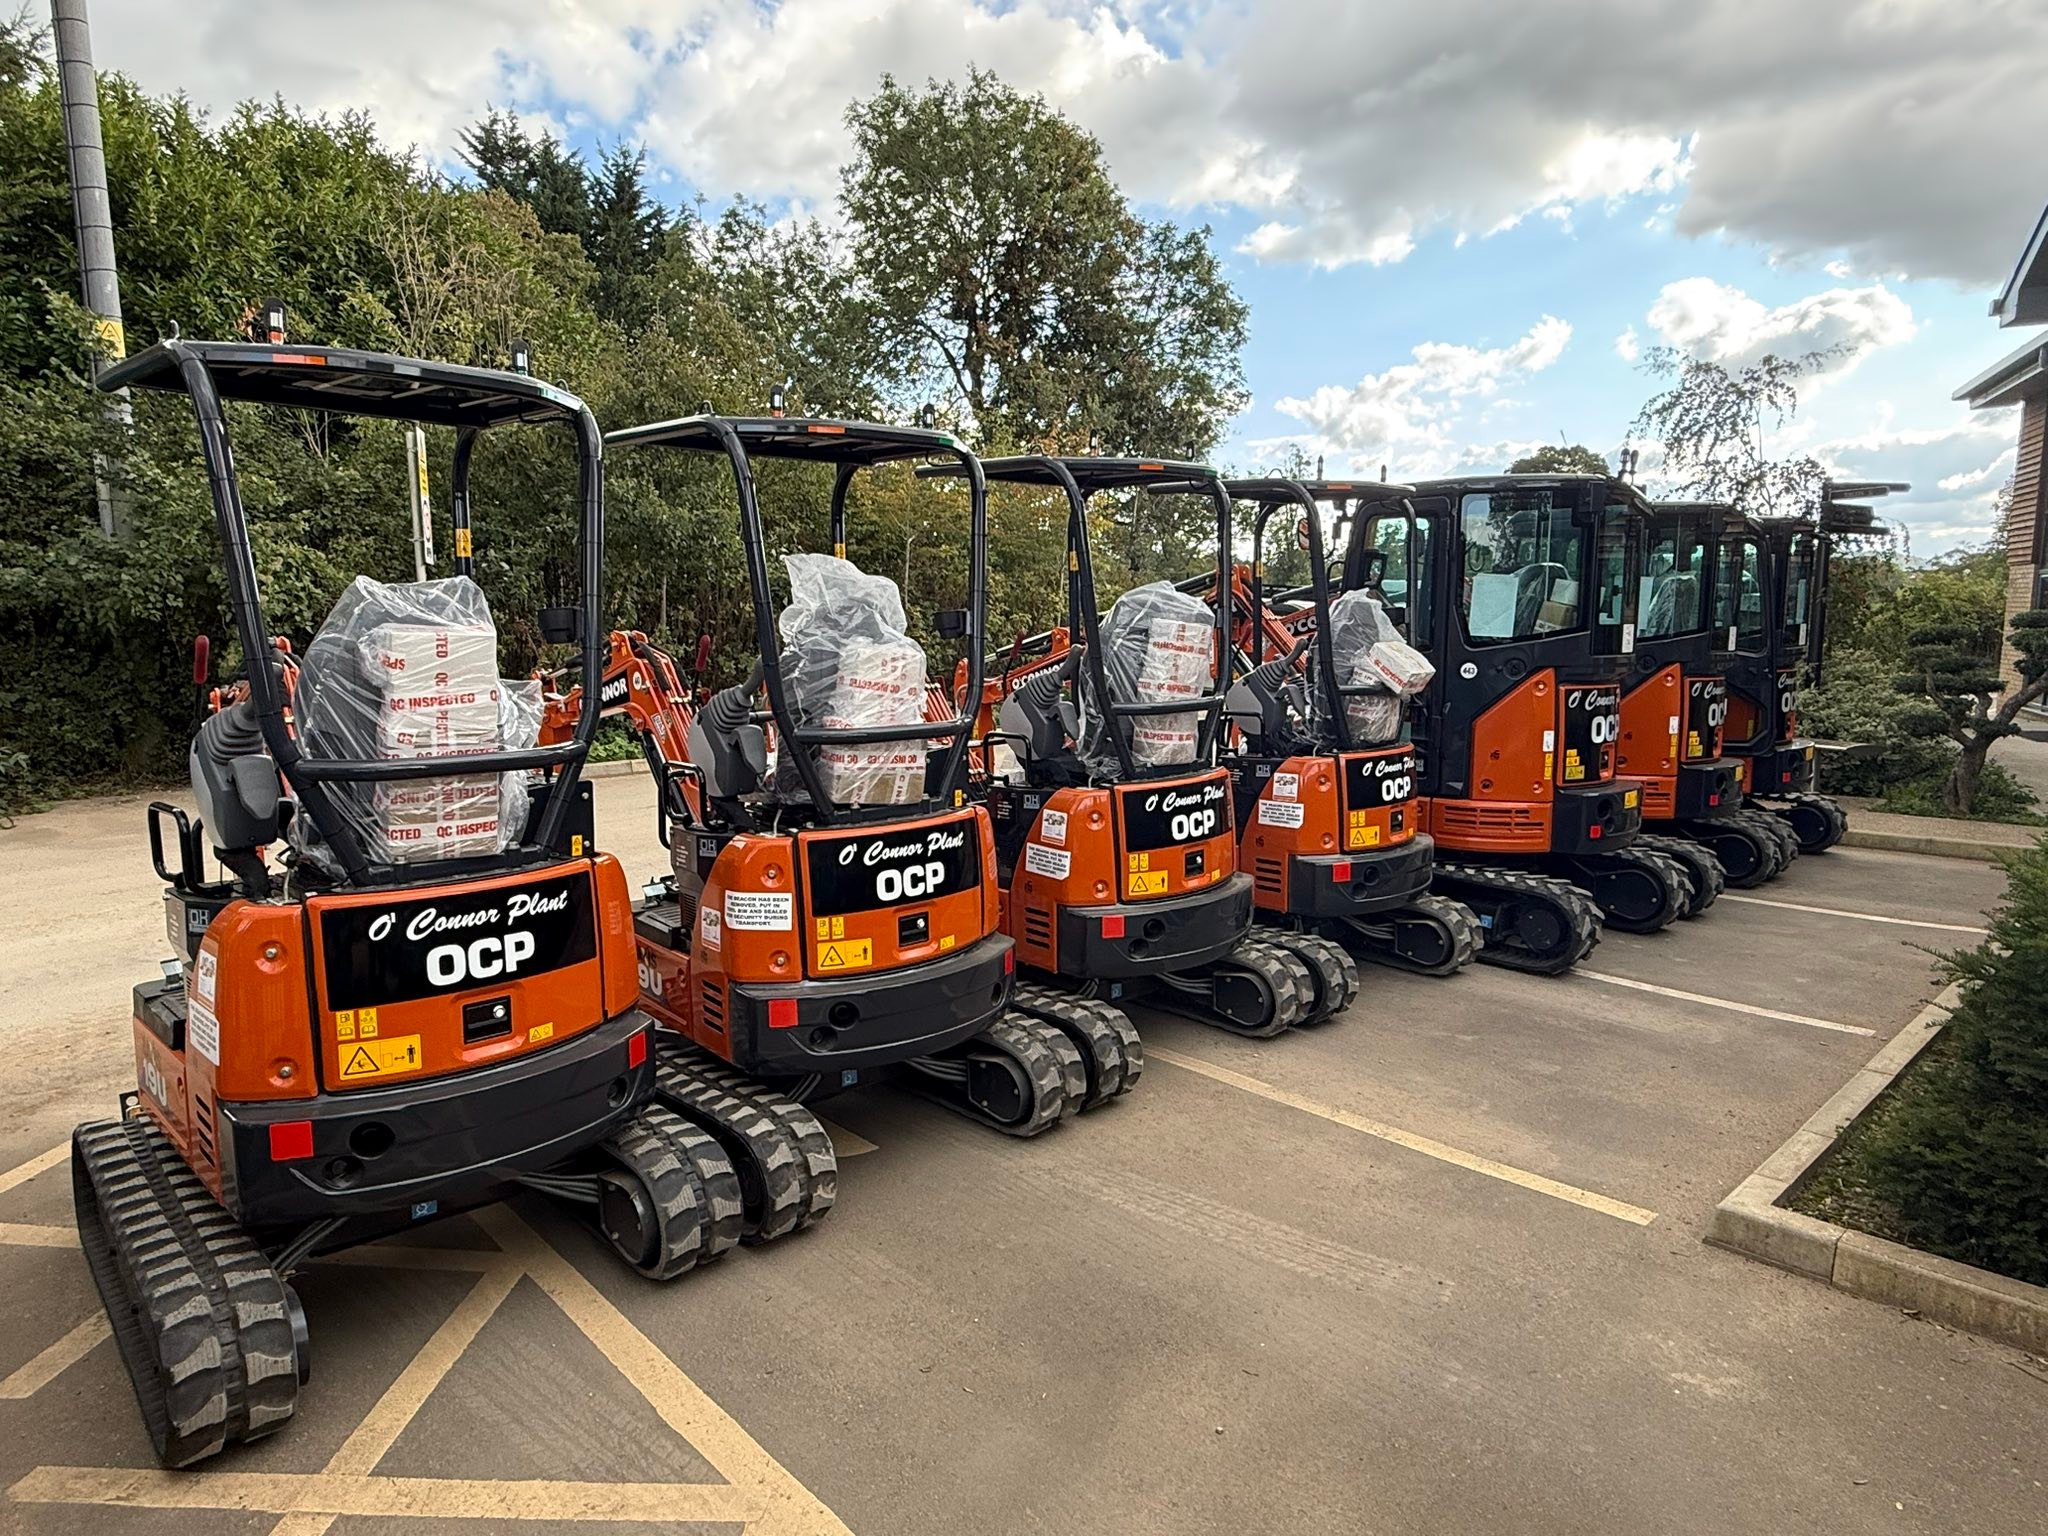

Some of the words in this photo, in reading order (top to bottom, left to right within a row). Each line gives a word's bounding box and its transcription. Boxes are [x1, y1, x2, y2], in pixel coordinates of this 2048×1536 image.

[390, 697, 405, 712] QC
[409, 692, 475, 708] INSPECTED
[1145, 794, 1159, 812] O'
[1382, 776, 1411, 801] OCP
[436, 825, 452, 838] QC
[456, 820, 498, 835] INSPEC
[1171, 809, 1215, 840] OCP
[839, 843, 857, 865] O'
[863, 841, 924, 866] Connor
[927, 831, 964, 857] Plant
[876, 861, 945, 901] OCP
[368, 912, 396, 941] O'
[406, 907, 500, 941] Connor
[507, 890, 568, 926] Plant
[426, 930, 535, 987] OCP
[638, 963, 663, 996] 9U
